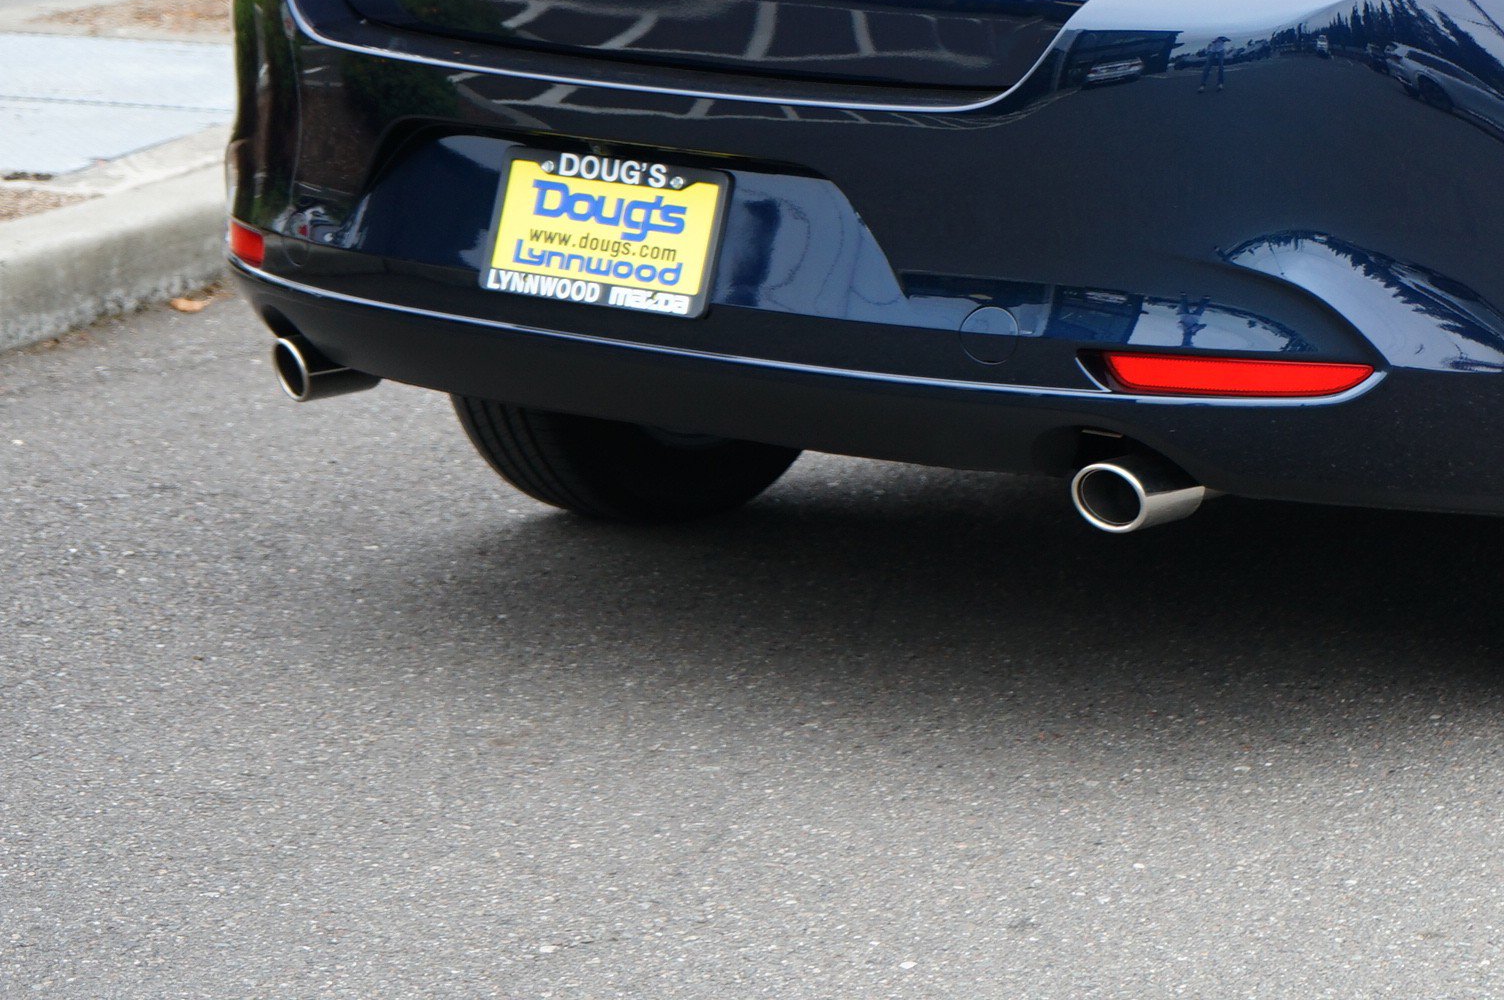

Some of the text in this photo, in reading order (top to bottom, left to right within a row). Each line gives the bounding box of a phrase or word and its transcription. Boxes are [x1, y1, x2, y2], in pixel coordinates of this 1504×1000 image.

[558, 152, 668, 189] DOUG'S
[512, 238, 684, 287] Lynnwood
[529, 227, 677, 263] www.dougs.com
[486, 267, 601, 304] LYNNWOOD
